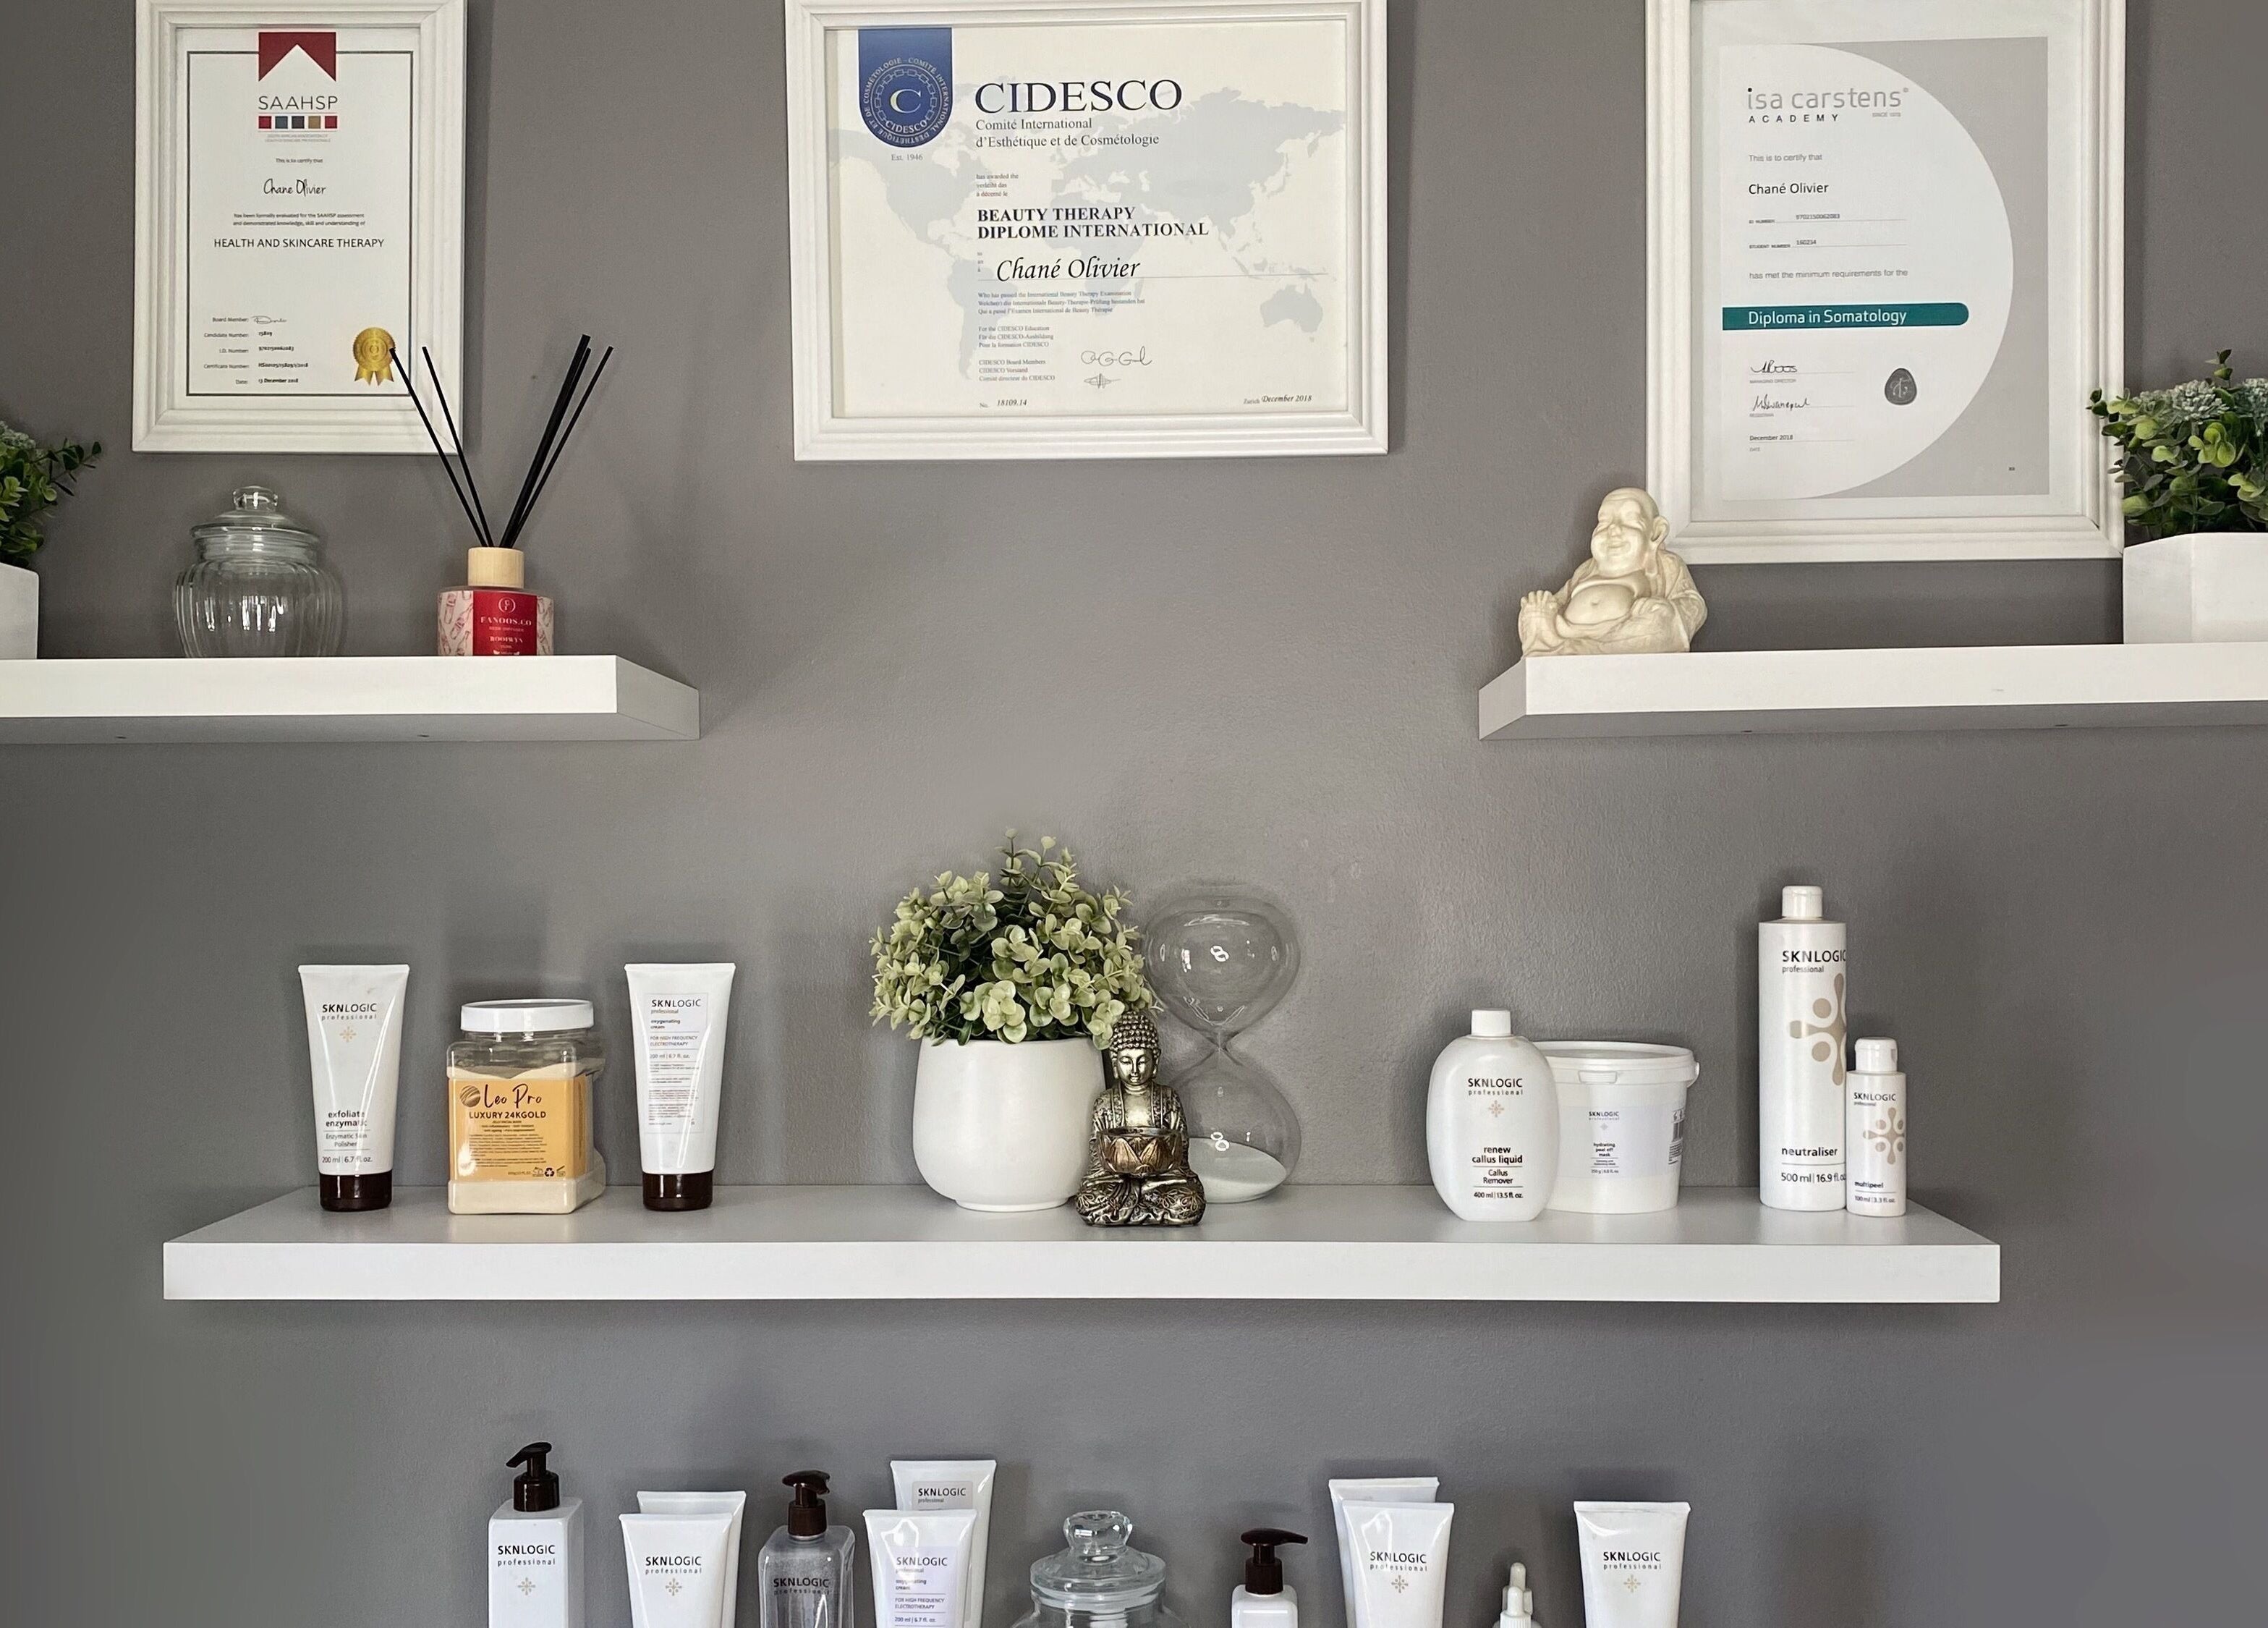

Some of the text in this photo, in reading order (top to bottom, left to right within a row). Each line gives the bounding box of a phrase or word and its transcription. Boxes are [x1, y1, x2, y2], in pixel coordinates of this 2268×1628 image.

[889, 88, 922, 114] C
[974, 80, 1183, 114] CIDESCO
[1747, 88, 1783, 109] isa
[258, 96, 338, 110] SAAHSP
[1749, 114, 1838, 123] ACADEMY
[885, 120, 927, 134] CIDESCO
[975, 118, 1092, 130] Comité International
[1063, 135, 1078, 145] de
[1080, 134, 1160, 147] Cosmétologie
[296, 179, 326, 196] Olivier
[1749, 183, 1829, 194] Chané Olivier
[977, 207, 1135, 221] BEAUTY THERAPY
[977, 223, 1209, 239] DIPLOME INTERNATIONAL
[214, 239, 384, 247] HEALTH AND SKINCARE THERAPY
[997, 257, 1061, 281] Chané
[1068, 255, 1141, 278] Olivier
[1749, 309, 1907, 326] Diploma in Somatology
[1262, 394, 1294, 403] December
[1783, 949, 1846, 962] SKNLOGIC
[1782, 965, 1825, 974] professional
[322, 1004, 377, 1013] SKNLOGIC
[1468, 1078, 1523, 1088] SKNLOGIC
[483, 1083, 543, 1108] Leo Pro
[1853, 1092, 1896, 1101] SKNLOGIC
[1782, 1147, 1838, 1156] neutraliser
[1498, 1155, 1523, 1165] liquid
[1781, 1172, 1832, 1182] 500 ml 16.9
[918, 1488, 967, 1496] SKNLOGIC
[498, 1545, 556, 1555] SKNLOGIC
[645, 1556, 702, 1566] SKNLOGIC
[896, 1556, 948, 1566] SKNLOGIC
[1369, 1551, 1427, 1564] SKNLOGIC
[1603, 1552, 1661, 1561] SKNLOGIC
[498, 1559, 556, 1567] professional
[1369, 1562, 1427, 1572] professional
[773, 1578, 830, 1588] SKNLOGIC
